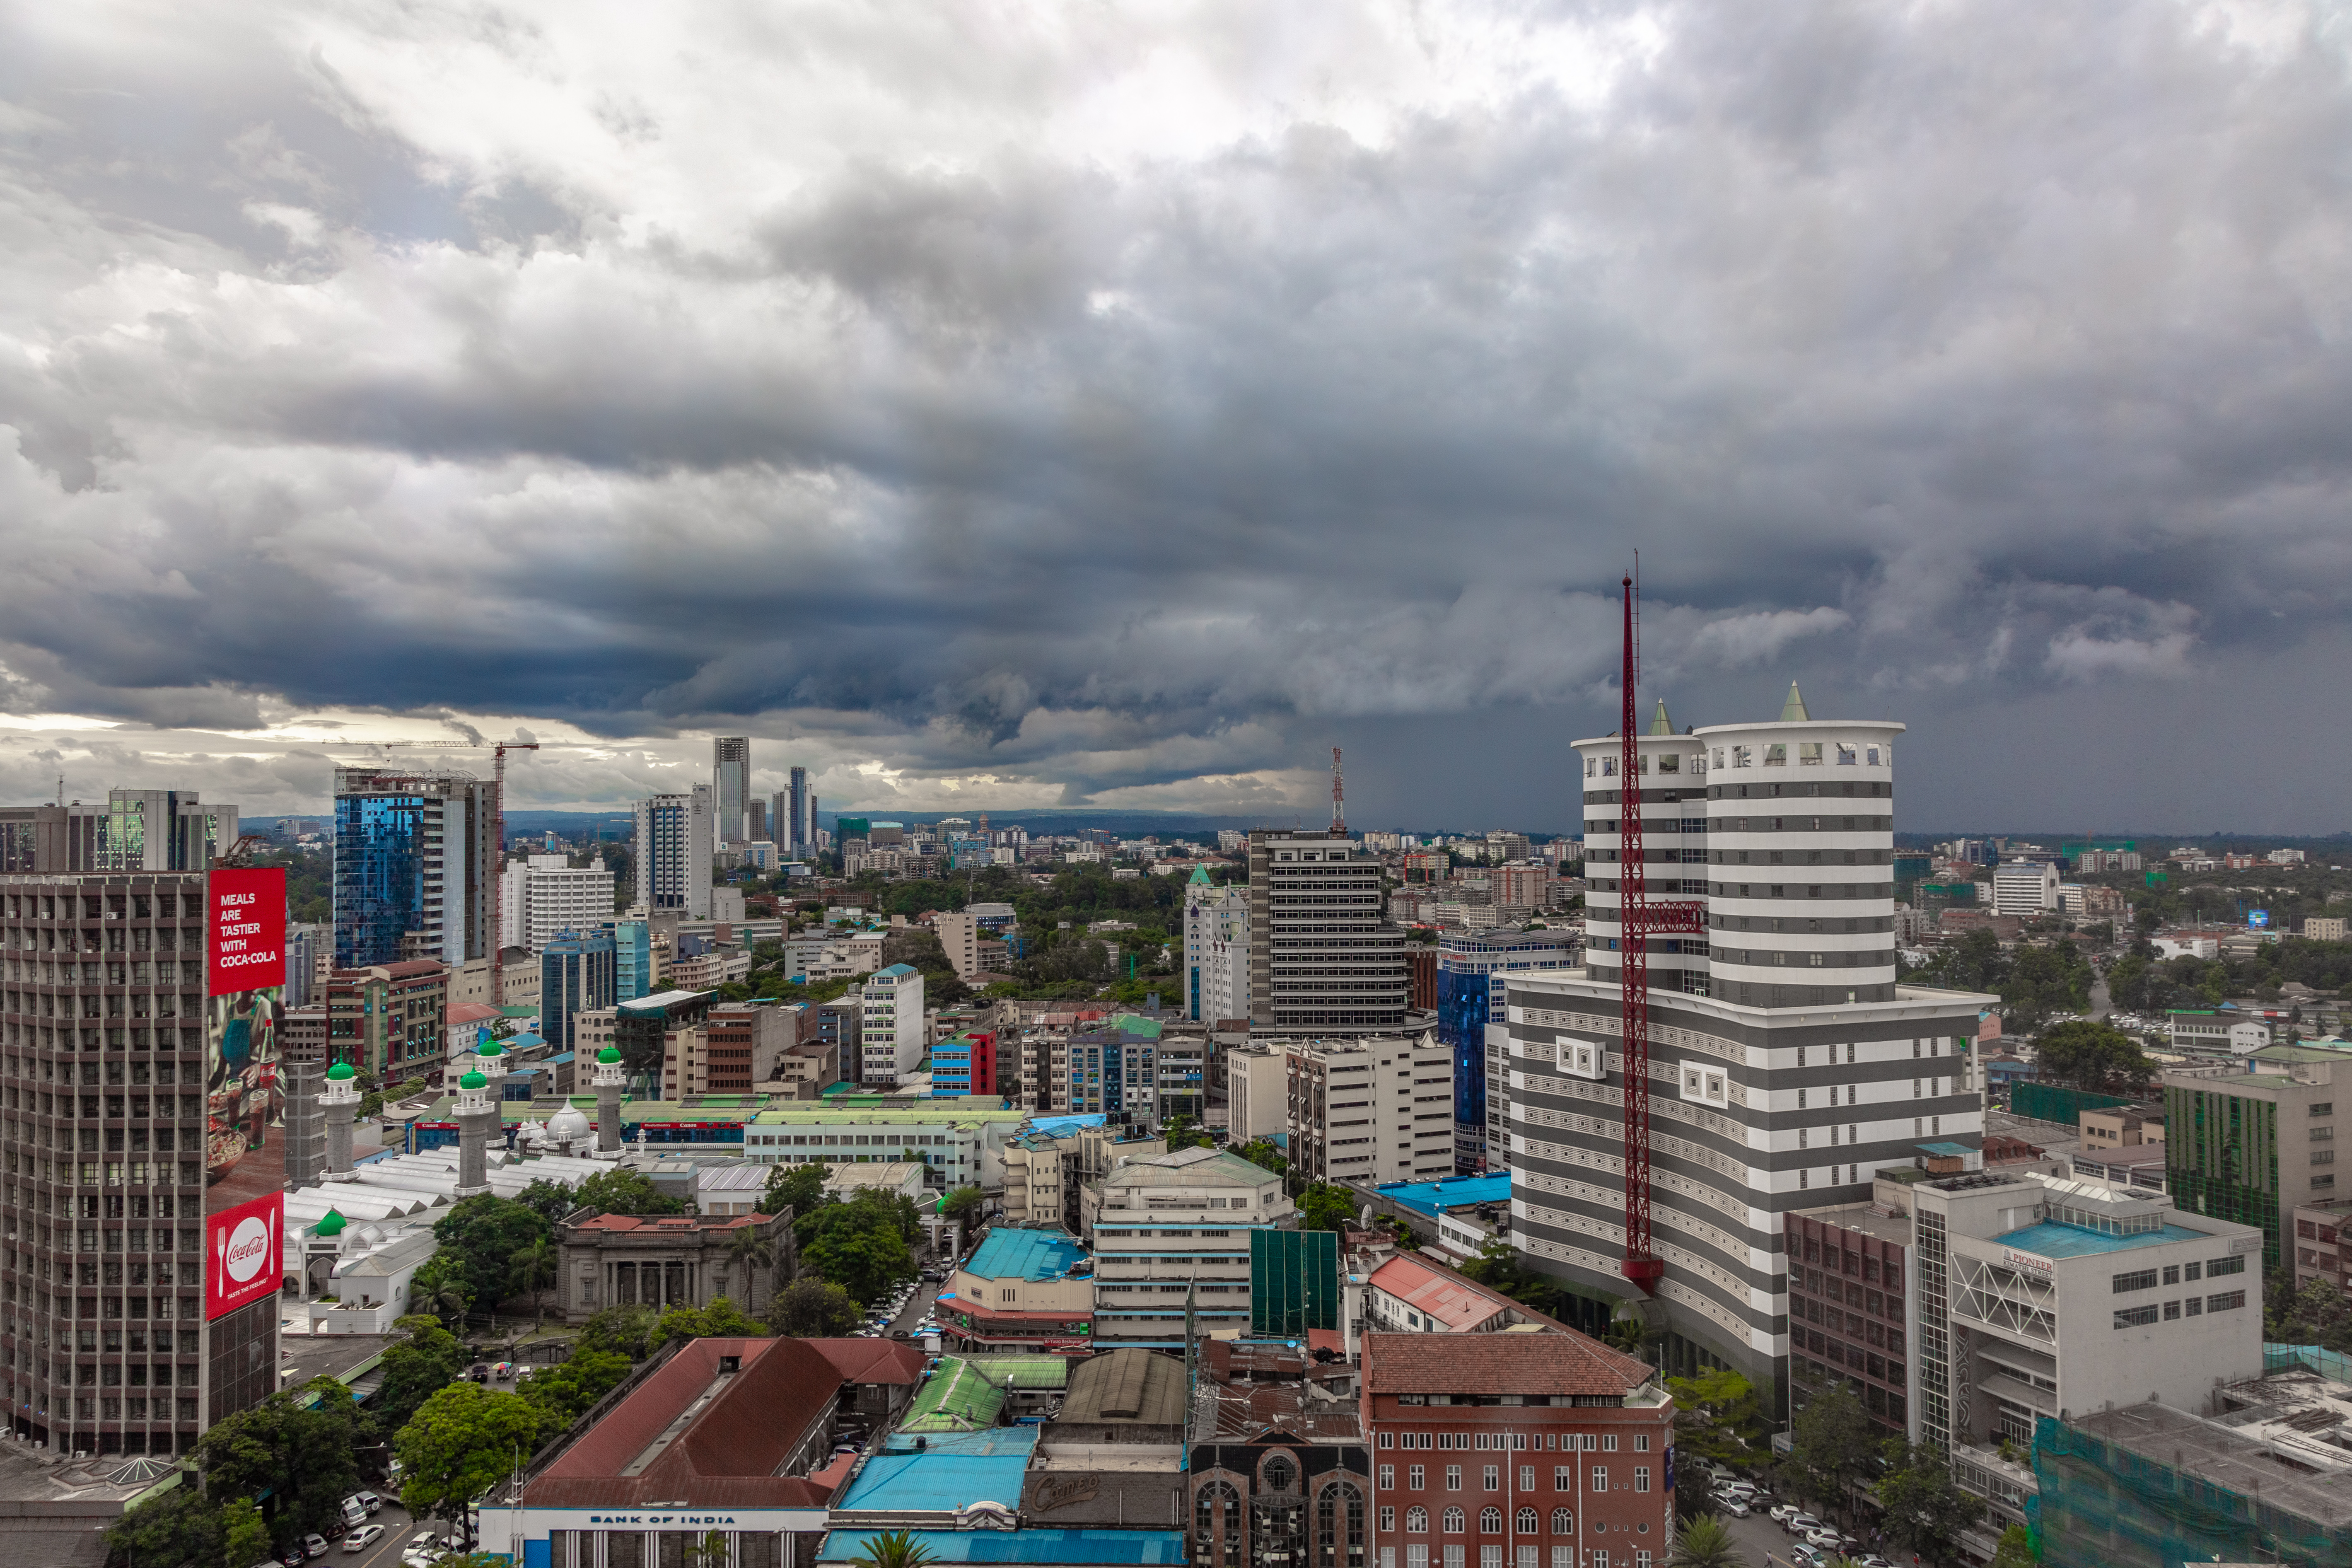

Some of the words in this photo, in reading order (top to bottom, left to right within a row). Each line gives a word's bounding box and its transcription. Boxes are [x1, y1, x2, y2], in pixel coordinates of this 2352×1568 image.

[221, 893, 255, 906] MEALS
[220, 909, 241, 922] ARE
[220, 923, 261, 937] TASTIER
[220, 939, 246, 952] WITH
[2013, 1253, 2053, 1271] PIONEER
[2003, 1260, 2029, 1271] KIMATHI
[2031, 1268, 2053, 1278] STREET
[227, 1290, 240, 1300] TASTE
